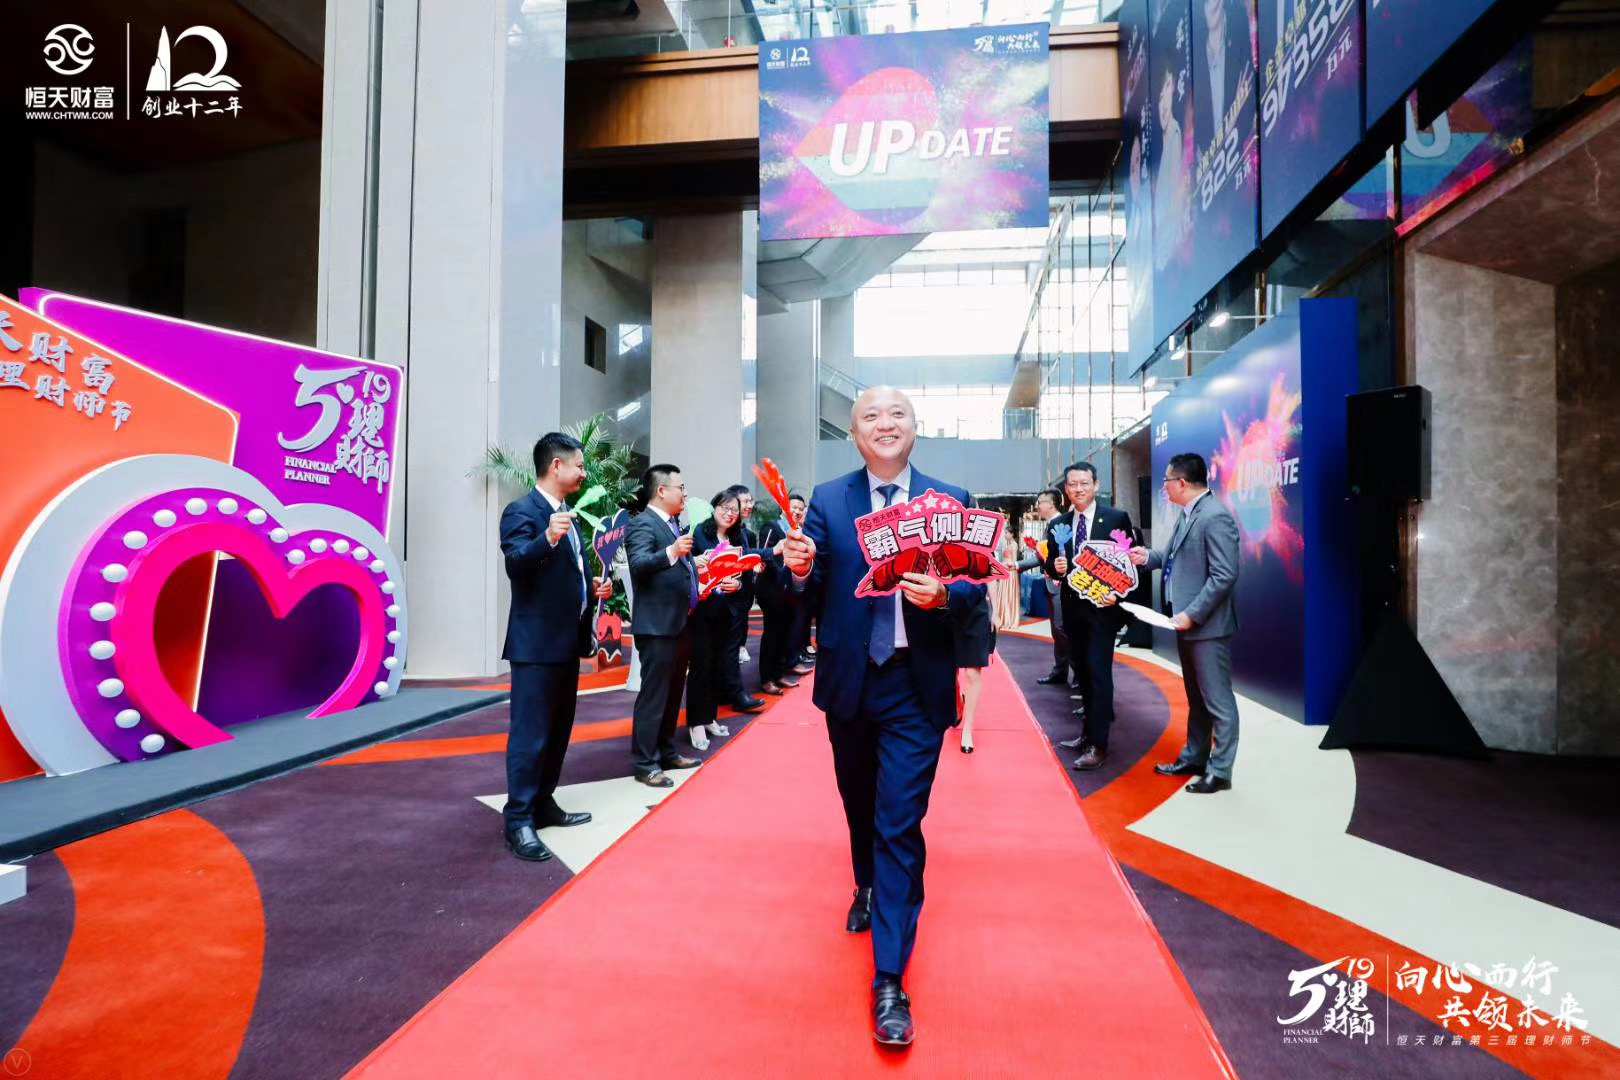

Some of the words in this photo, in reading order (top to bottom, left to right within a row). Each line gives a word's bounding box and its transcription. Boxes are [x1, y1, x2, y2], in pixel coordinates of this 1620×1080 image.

[829, 119, 1013, 177] UPDATE
[1201, 127, 1239, 212] 822
[284, 469, 331, 485] PLANNER
[285, 456, 337, 474] FINANCIAL
[863, 512, 1000, 561] 霸气侧漏
